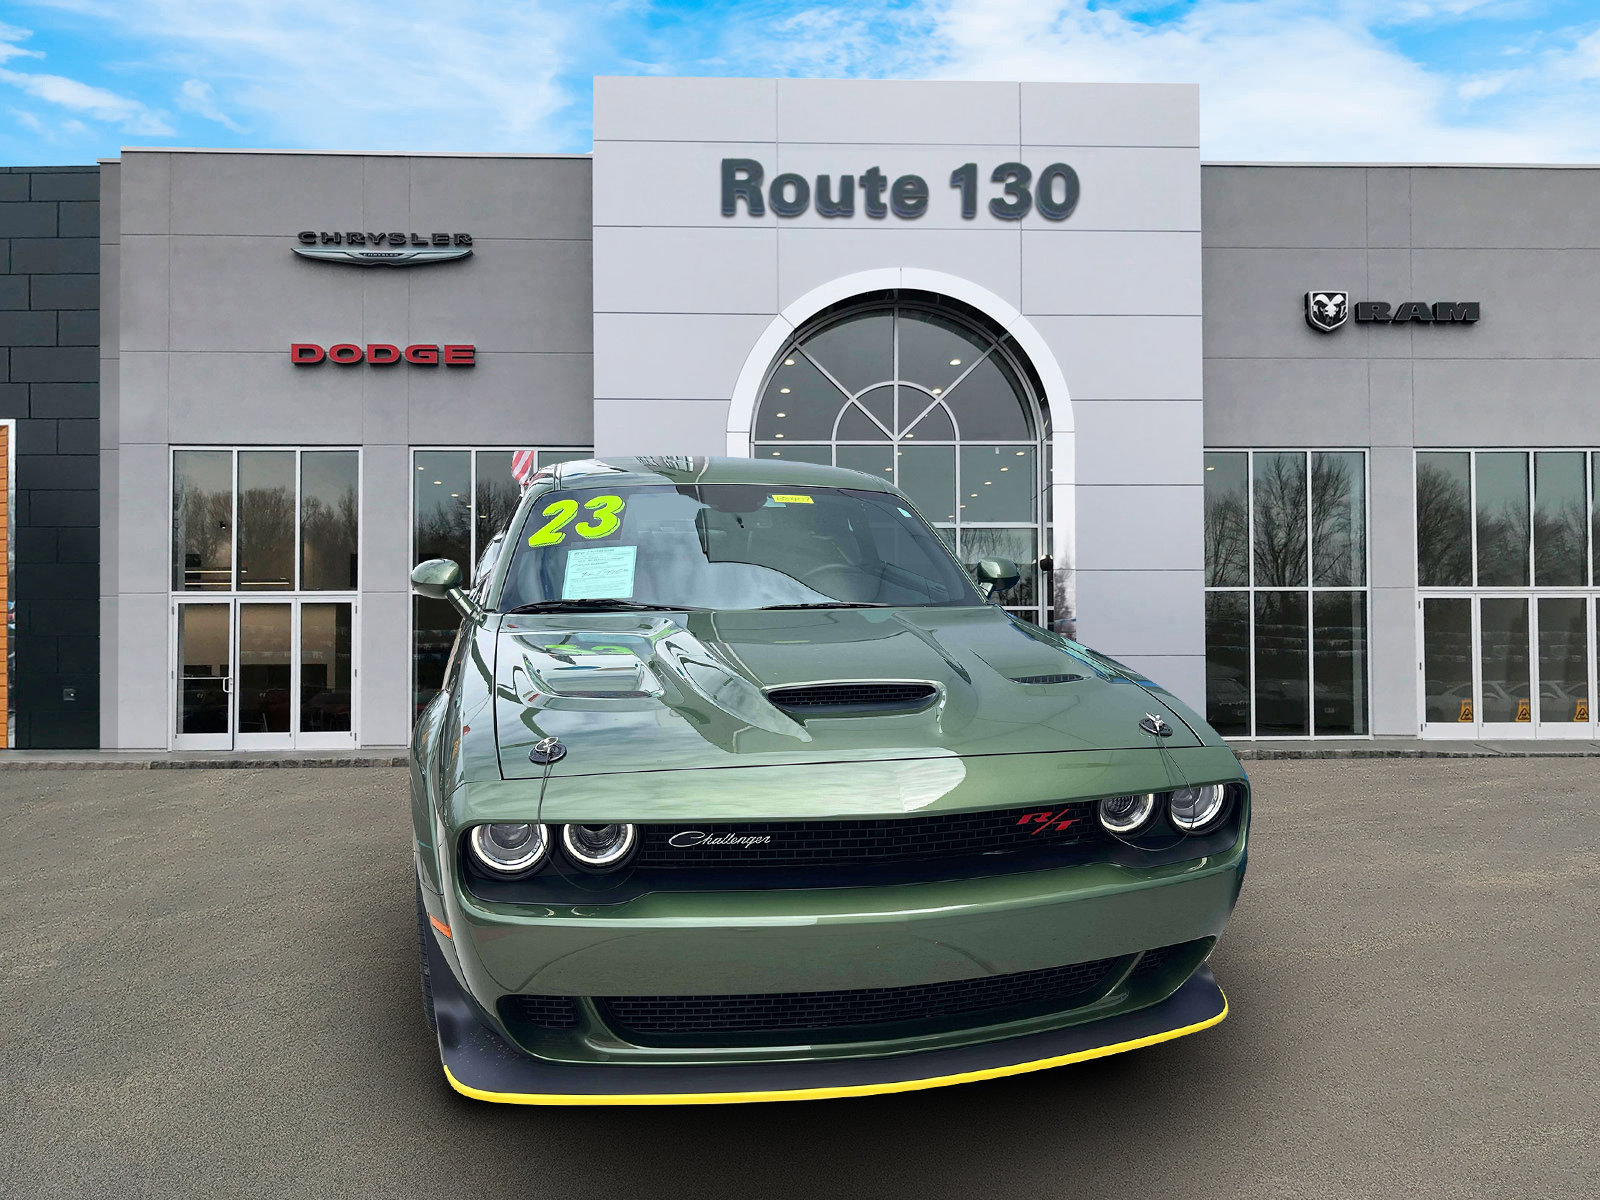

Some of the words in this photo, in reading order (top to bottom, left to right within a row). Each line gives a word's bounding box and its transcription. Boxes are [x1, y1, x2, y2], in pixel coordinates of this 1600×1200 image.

[721, 157, 930, 219] Route
[949, 162, 1081, 221] 130
[298, 231, 473, 246] CHRYSLER
[1355, 301, 1481, 324] RAM
[291, 343, 476, 366] DODGE
[528, 495, 626, 548] 23
[1016, 808, 1081, 835] R/T
[668, 830, 771, 849] Challenger
